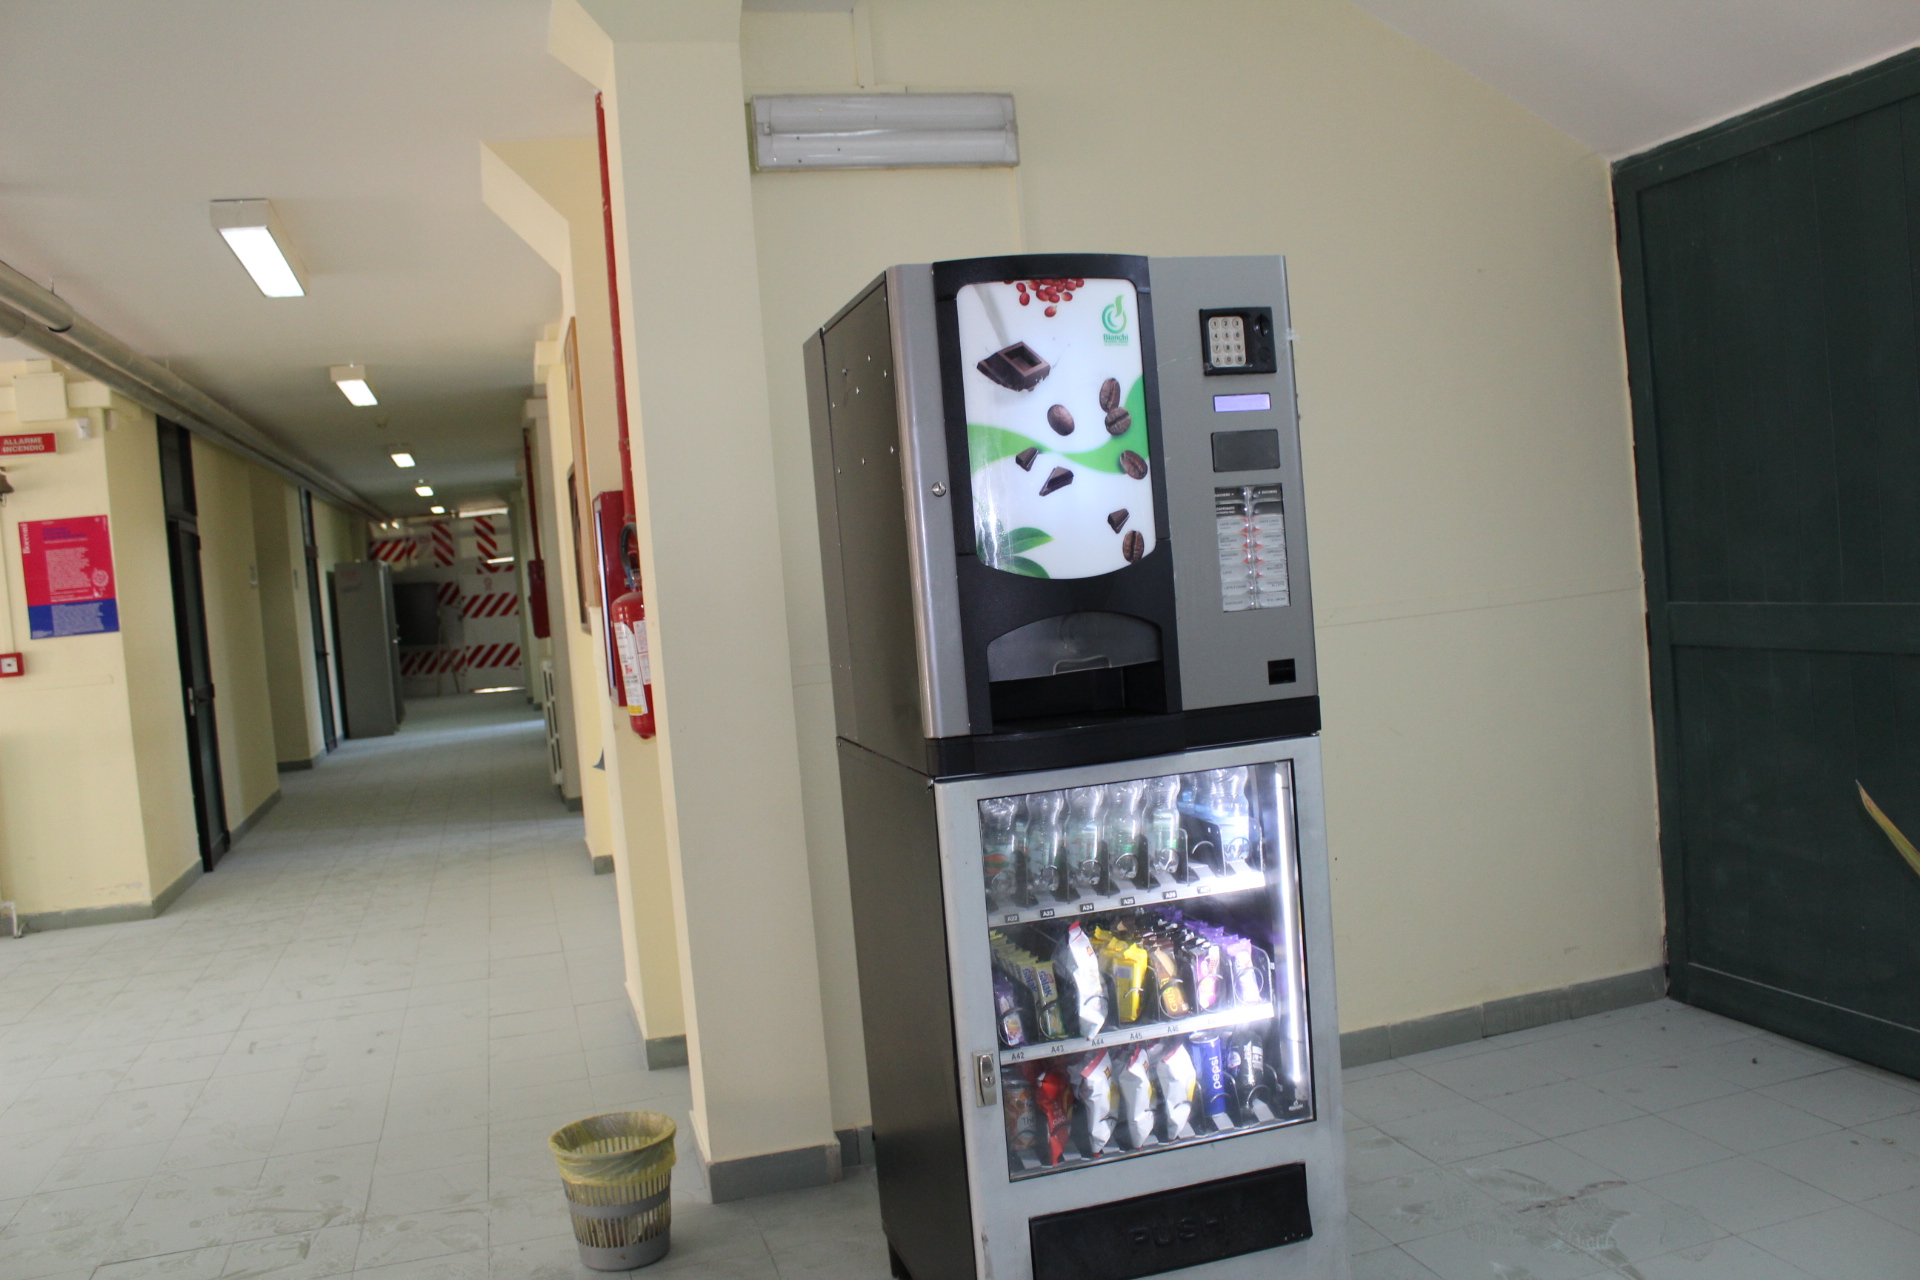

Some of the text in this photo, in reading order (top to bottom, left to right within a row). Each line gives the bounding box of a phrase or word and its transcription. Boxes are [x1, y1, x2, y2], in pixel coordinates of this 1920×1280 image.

[1103, 333, 1129, 341] Bianchi
[4, 437, 43, 446] ALLARME
[2, 445, 45, 453] INCENDIO
[1011, 1051, 1025, 1060] A42
[1051, 1045, 1064, 1053] A43
[1091, 1038, 1104, 1047] A44
[1208, 1056, 1223, 1090] pepsi
